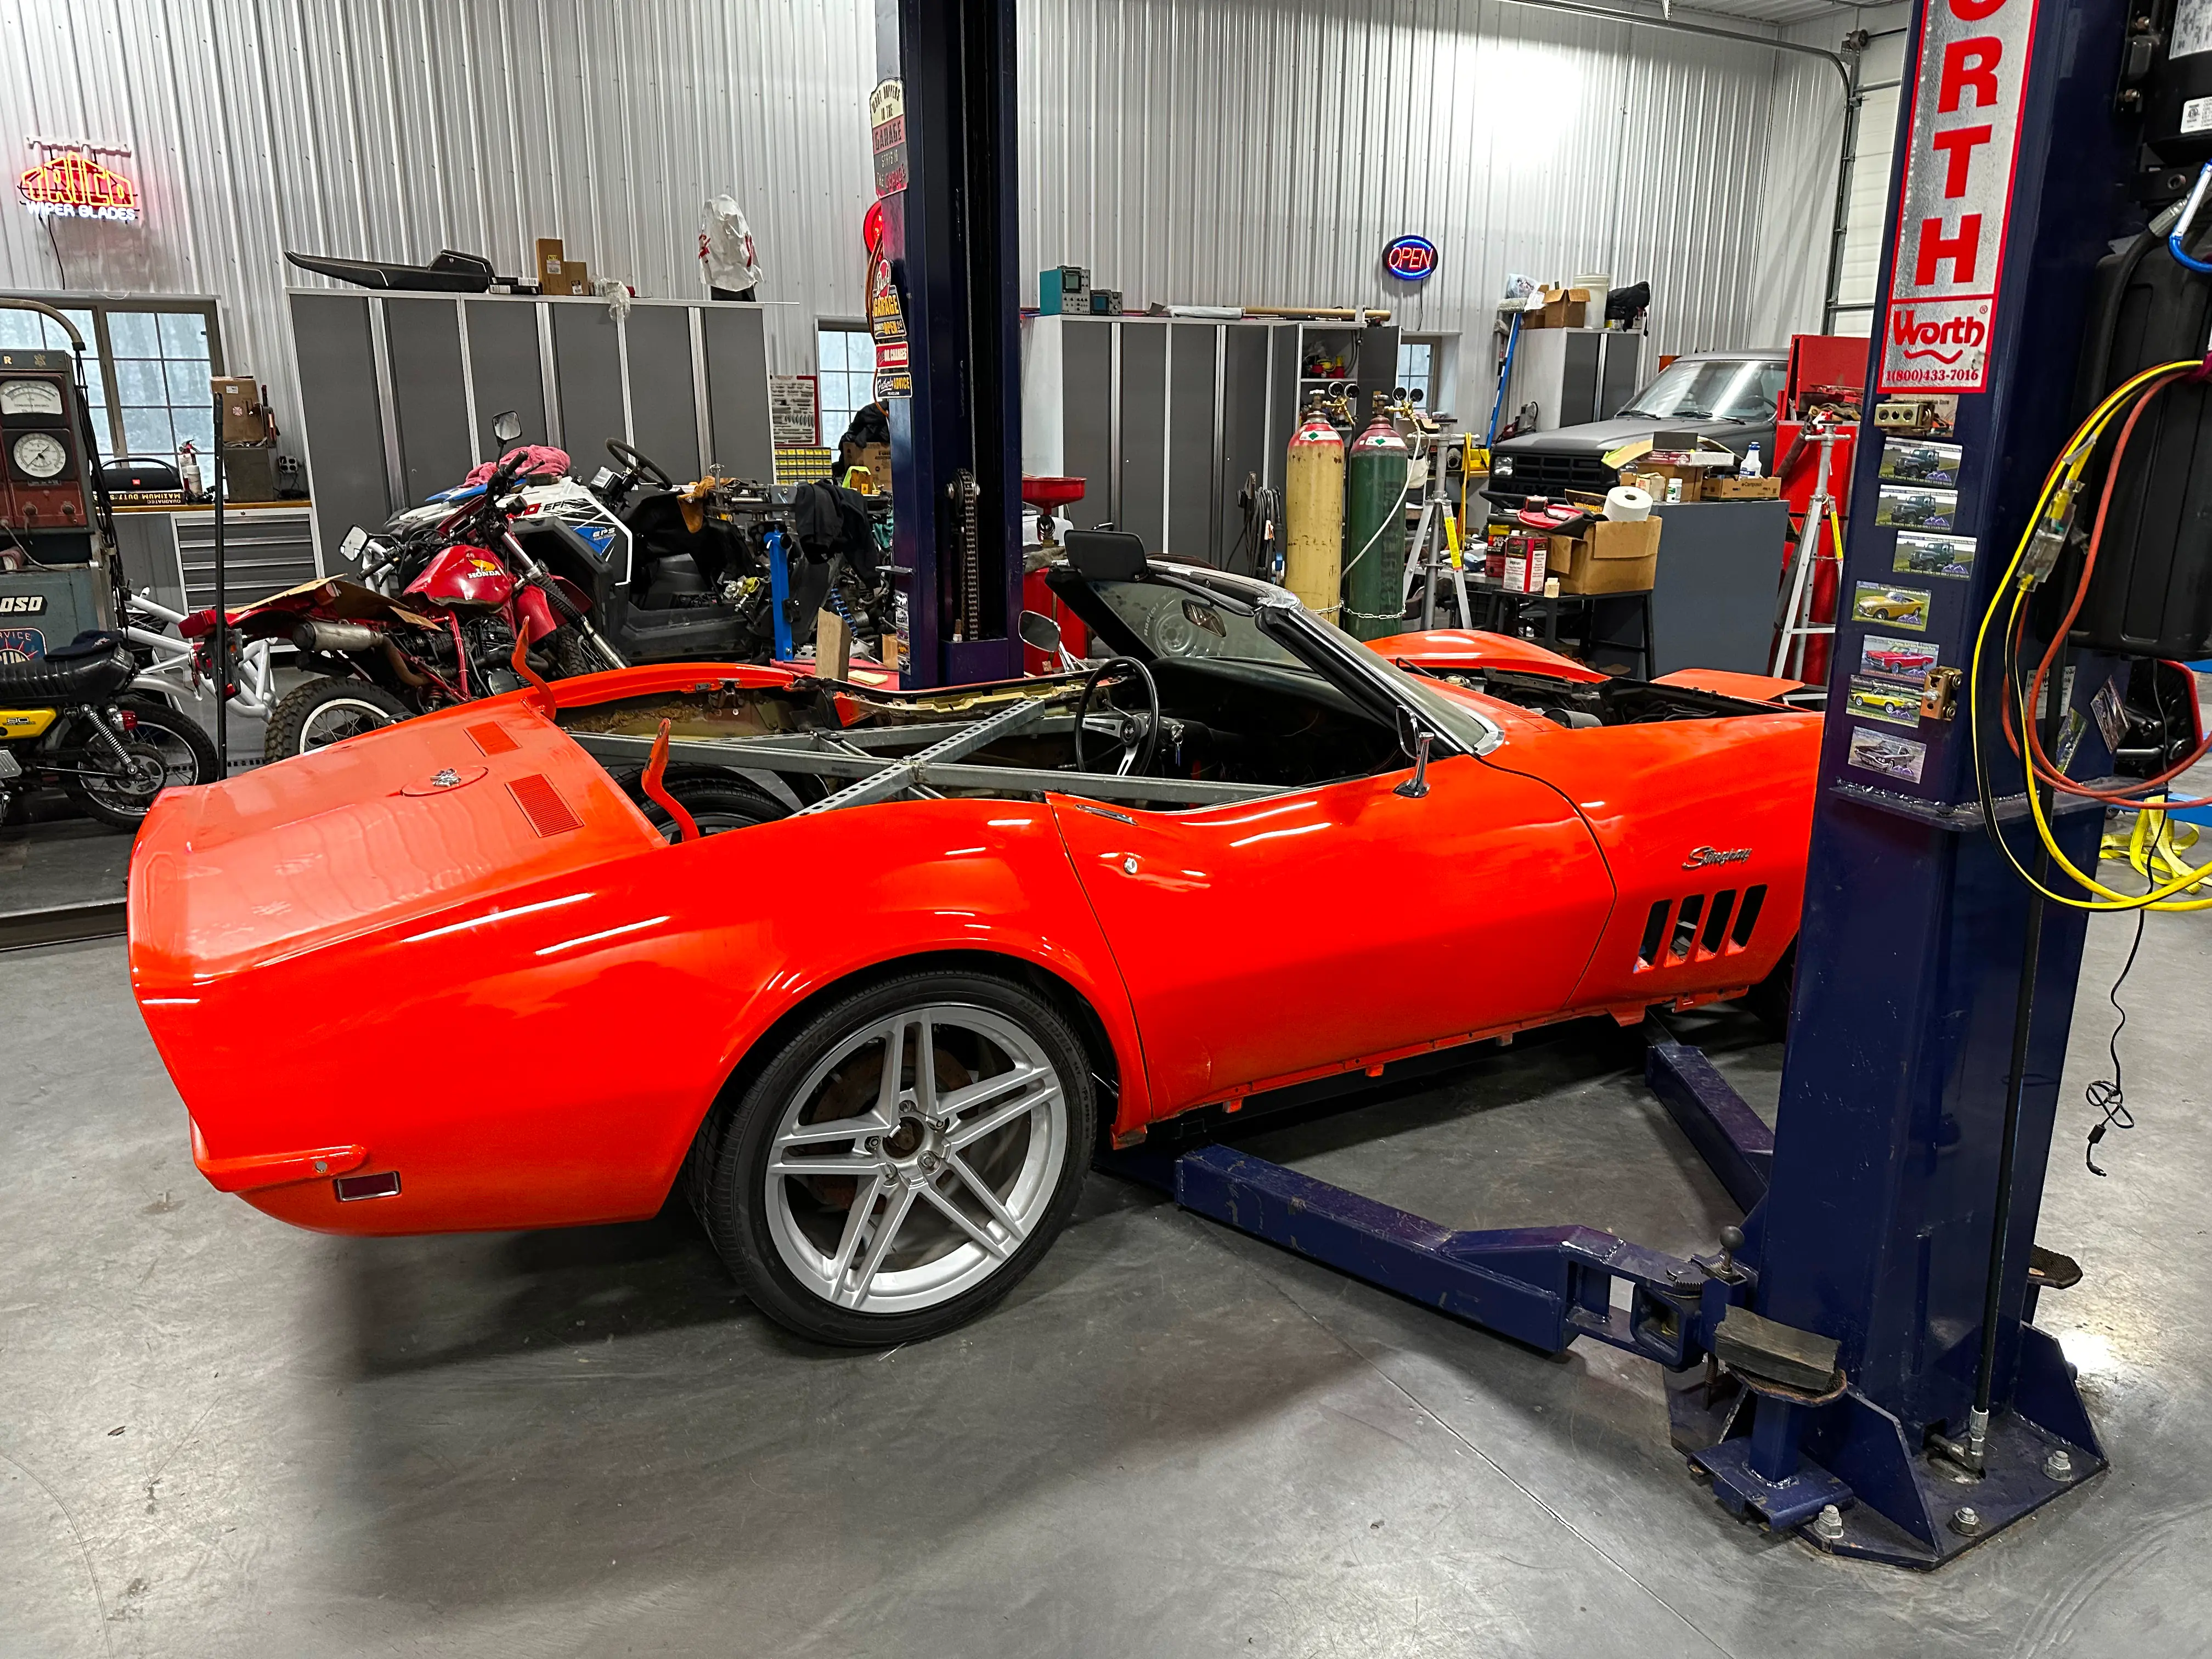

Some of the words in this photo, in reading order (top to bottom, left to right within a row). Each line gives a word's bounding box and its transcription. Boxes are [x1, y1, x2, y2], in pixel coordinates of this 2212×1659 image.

[874, 120, 902, 151] GARAGE
[1915, 0, 2006, 286] RTH
[20, 151, 134, 207] TRICO
[25, 200, 75, 217] WIPER
[78, 204, 136, 221] BLADES
[1389, 247, 1434, 268] OPEN
[873, 295, 900, 318] GARAGE
[883, 320, 898, 335] OPEN
[1893, 310, 1985, 347] Worth
[890, 347, 907, 362] CHANGES
[893, 377, 910, 390] ADVICE
[1886, 368, 1979, 383] 1(800)433-7016
[467, 569, 501, 579] HONDA
[1681, 845, 1752, 868] Stingray
